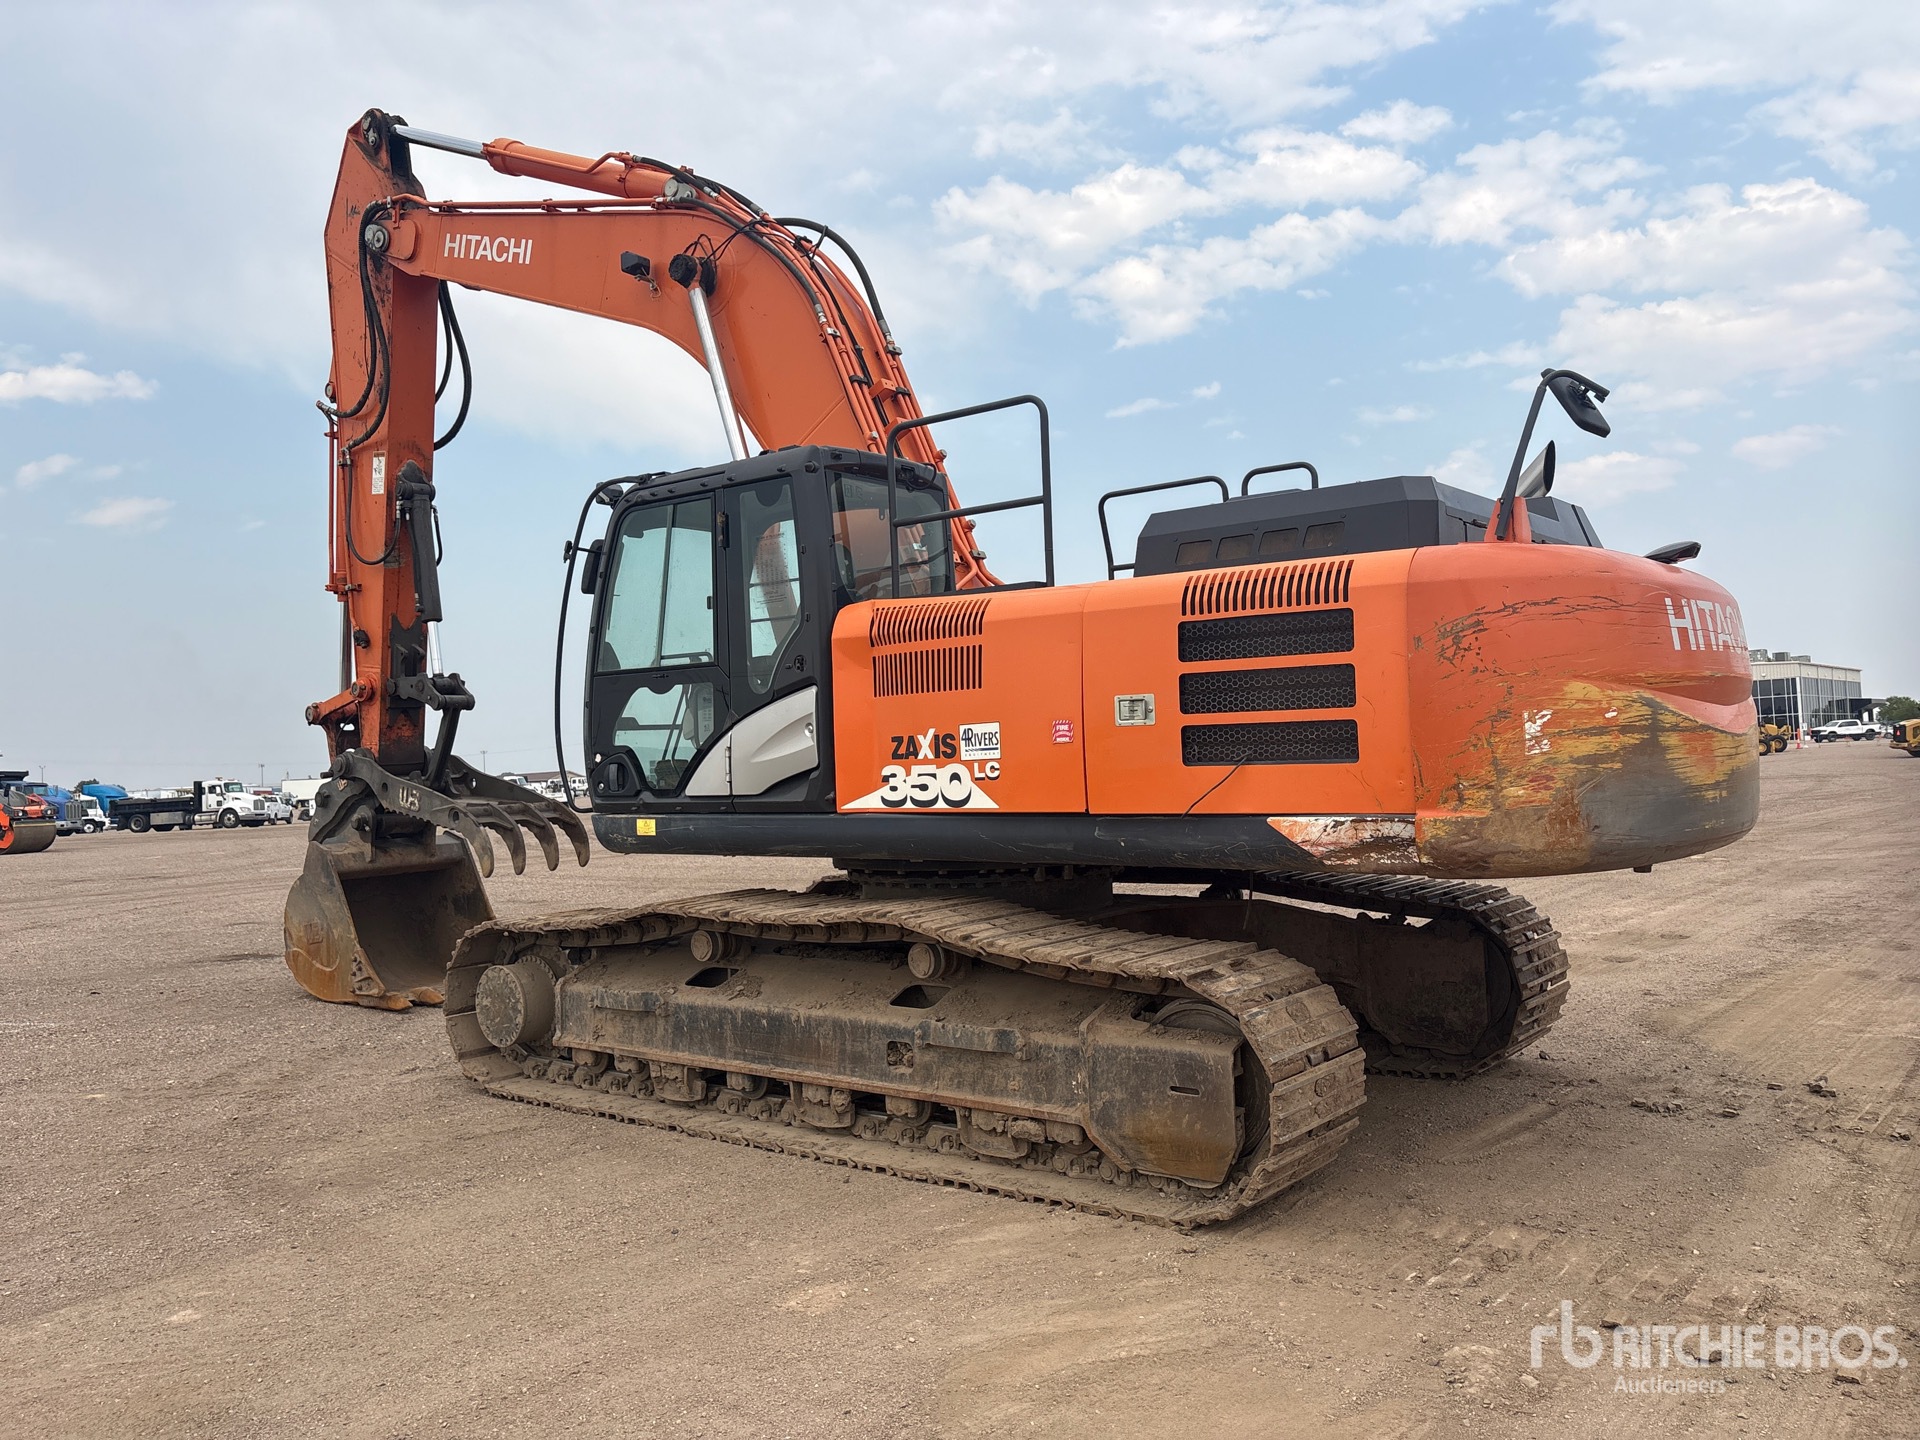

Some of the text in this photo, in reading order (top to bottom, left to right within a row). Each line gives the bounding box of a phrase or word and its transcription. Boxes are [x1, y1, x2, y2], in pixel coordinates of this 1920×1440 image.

[443, 233, 533, 264] HITACHI
[1664, 597, 1748, 655] HITAC
[891, 728, 957, 760] ZAXIS
[880, 761, 1001, 809] 350 LC
